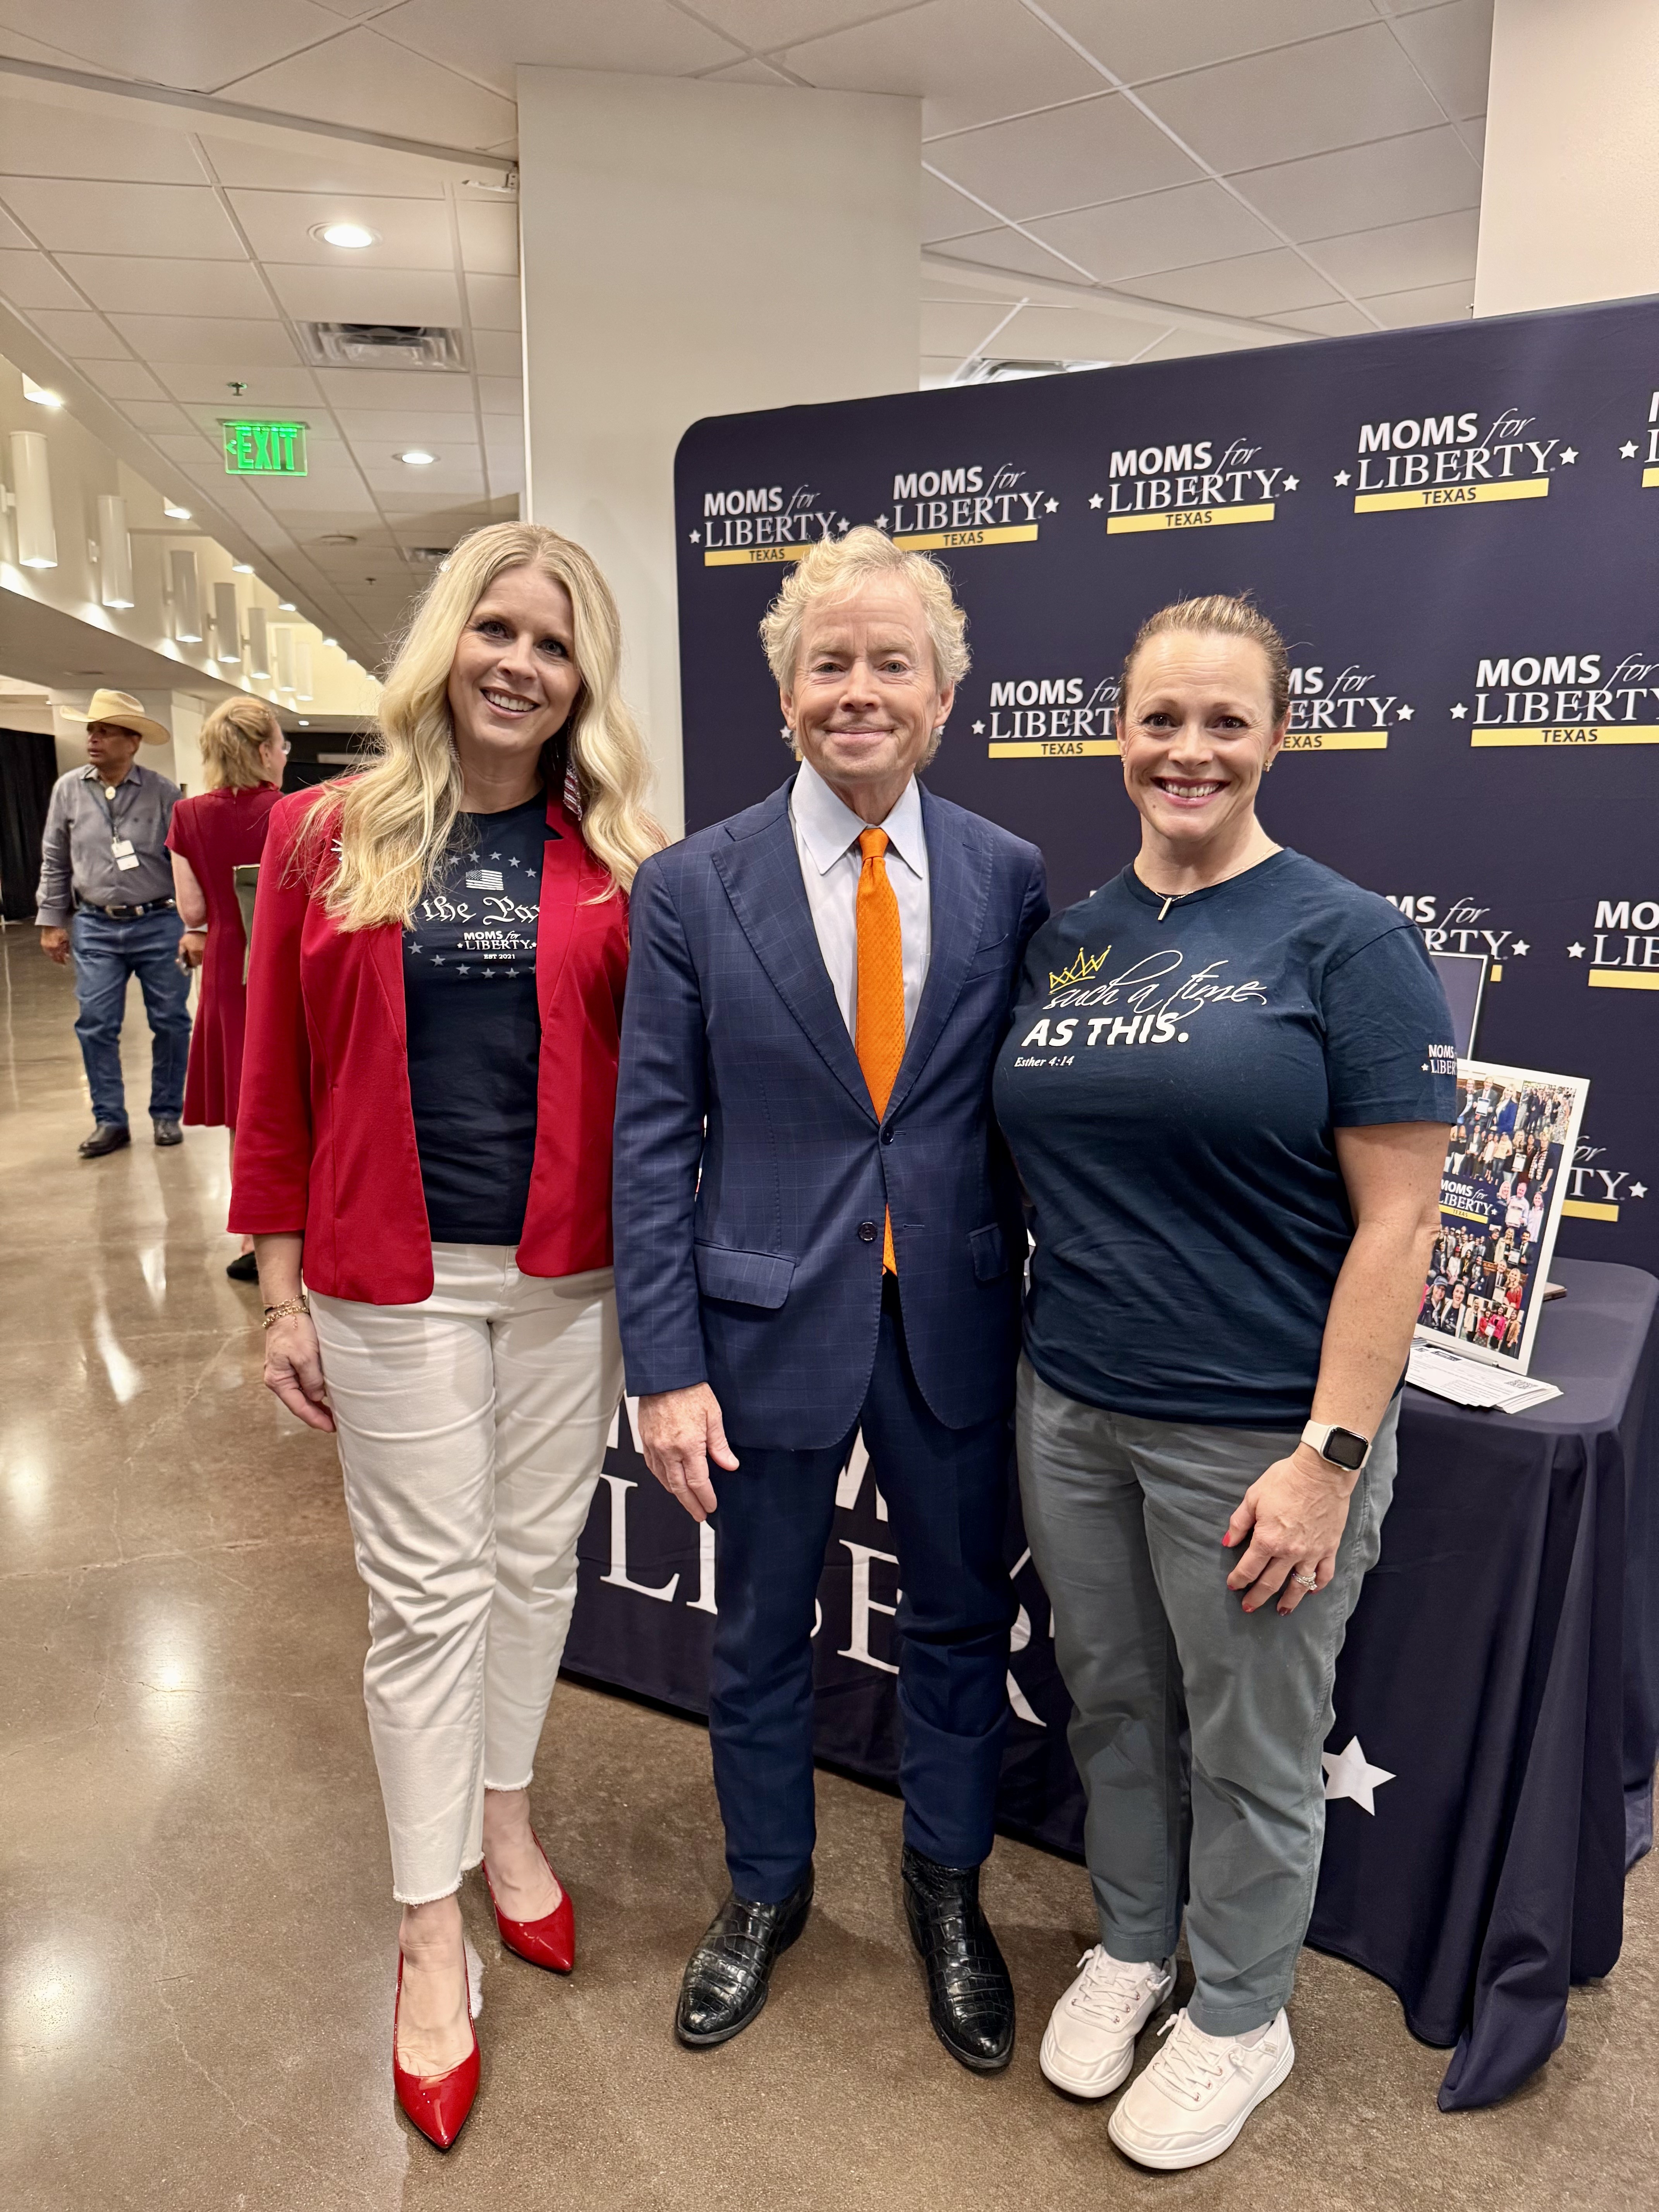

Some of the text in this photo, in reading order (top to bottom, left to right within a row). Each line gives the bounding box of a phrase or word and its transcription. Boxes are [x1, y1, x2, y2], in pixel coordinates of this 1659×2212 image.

[235, 426, 297, 470] EXIT
[1358, 413, 1478, 453] MOMS
[1109, 441, 1212, 478] MOMS
[1356, 440, 1559, 491] LIBERTY
[893, 466, 983, 500] MOMS
[1108, 467, 1283, 513] LIBERTY
[1422, 487, 1476, 505] TEXAS
[704, 486, 783, 517] MOMS
[893, 490, 1044, 532] LIBERTY
[704, 511, 837, 547] LIBERTY
[1166, 511, 1212, 527] TEXAS
[943, 531, 983, 546] TEXAS
[749, 548, 785, 562] TEXAS
[1475, 654, 1601, 687] MOMS
[990, 677, 1084, 707] MOMS
[1473, 688, 1659, 725] LIBERT
[989, 707, 1118, 739] LIBERT
[1287, 697, 1397, 730] ERTY
[1041, 742, 1083, 755] TEXAS
[1283, 735, 1322, 749] EXAS
[1542, 728, 1598, 743] TEXAS
[422, 896, 476, 923] the
[464, 931, 521, 940] MOMS for
[1042, 950, 1267, 1023] such a time
[1021, 1012, 1189, 1046] AS THIS.
[1014, 1055, 1075, 1067] Esther 4:14
[1428, 1044, 1454, 1059] MOMS
[1430, 1059, 1456, 1075] LIBER
[1441, 1179, 1488, 1200] MOMS for
[1453, 1209, 1468, 1217] TEXAS
